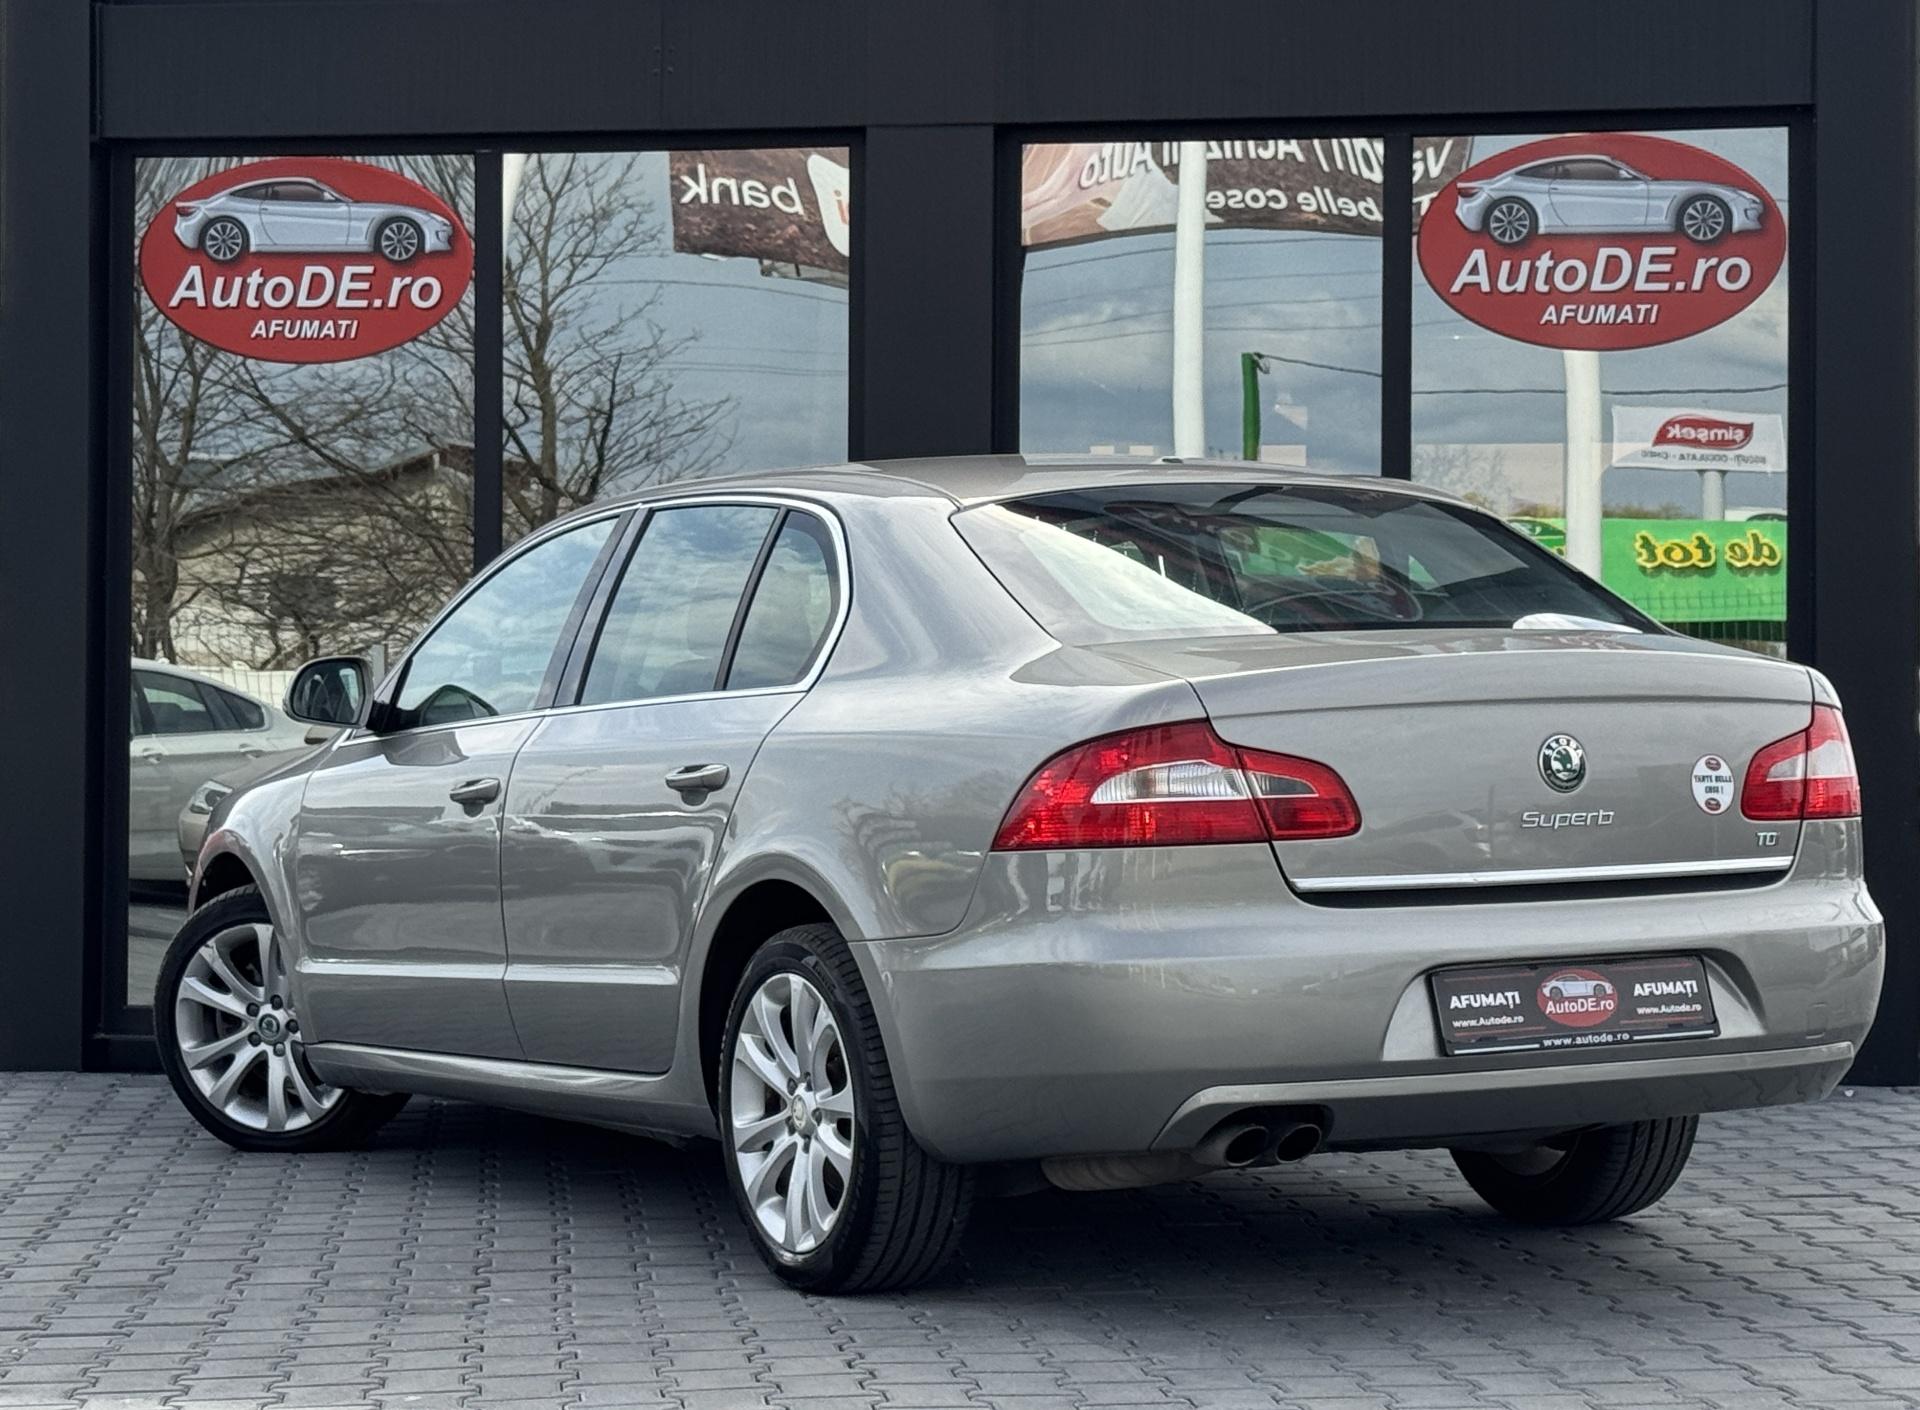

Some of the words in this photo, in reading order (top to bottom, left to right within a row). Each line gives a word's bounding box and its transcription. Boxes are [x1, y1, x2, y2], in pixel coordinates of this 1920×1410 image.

[1450, 247, 1752, 293] AutoDE.ro
[168, 265, 442, 309] AutoDE.ro
[1540, 304, 1659, 325] AFUMATI
[250, 320, 358, 339] AFUMATI
[1521, 809, 1615, 829] Superb
[1545, 998, 1615, 1015] AutoDE.ro
[1543, 1032, 1630, 1047] www.autode.ro
